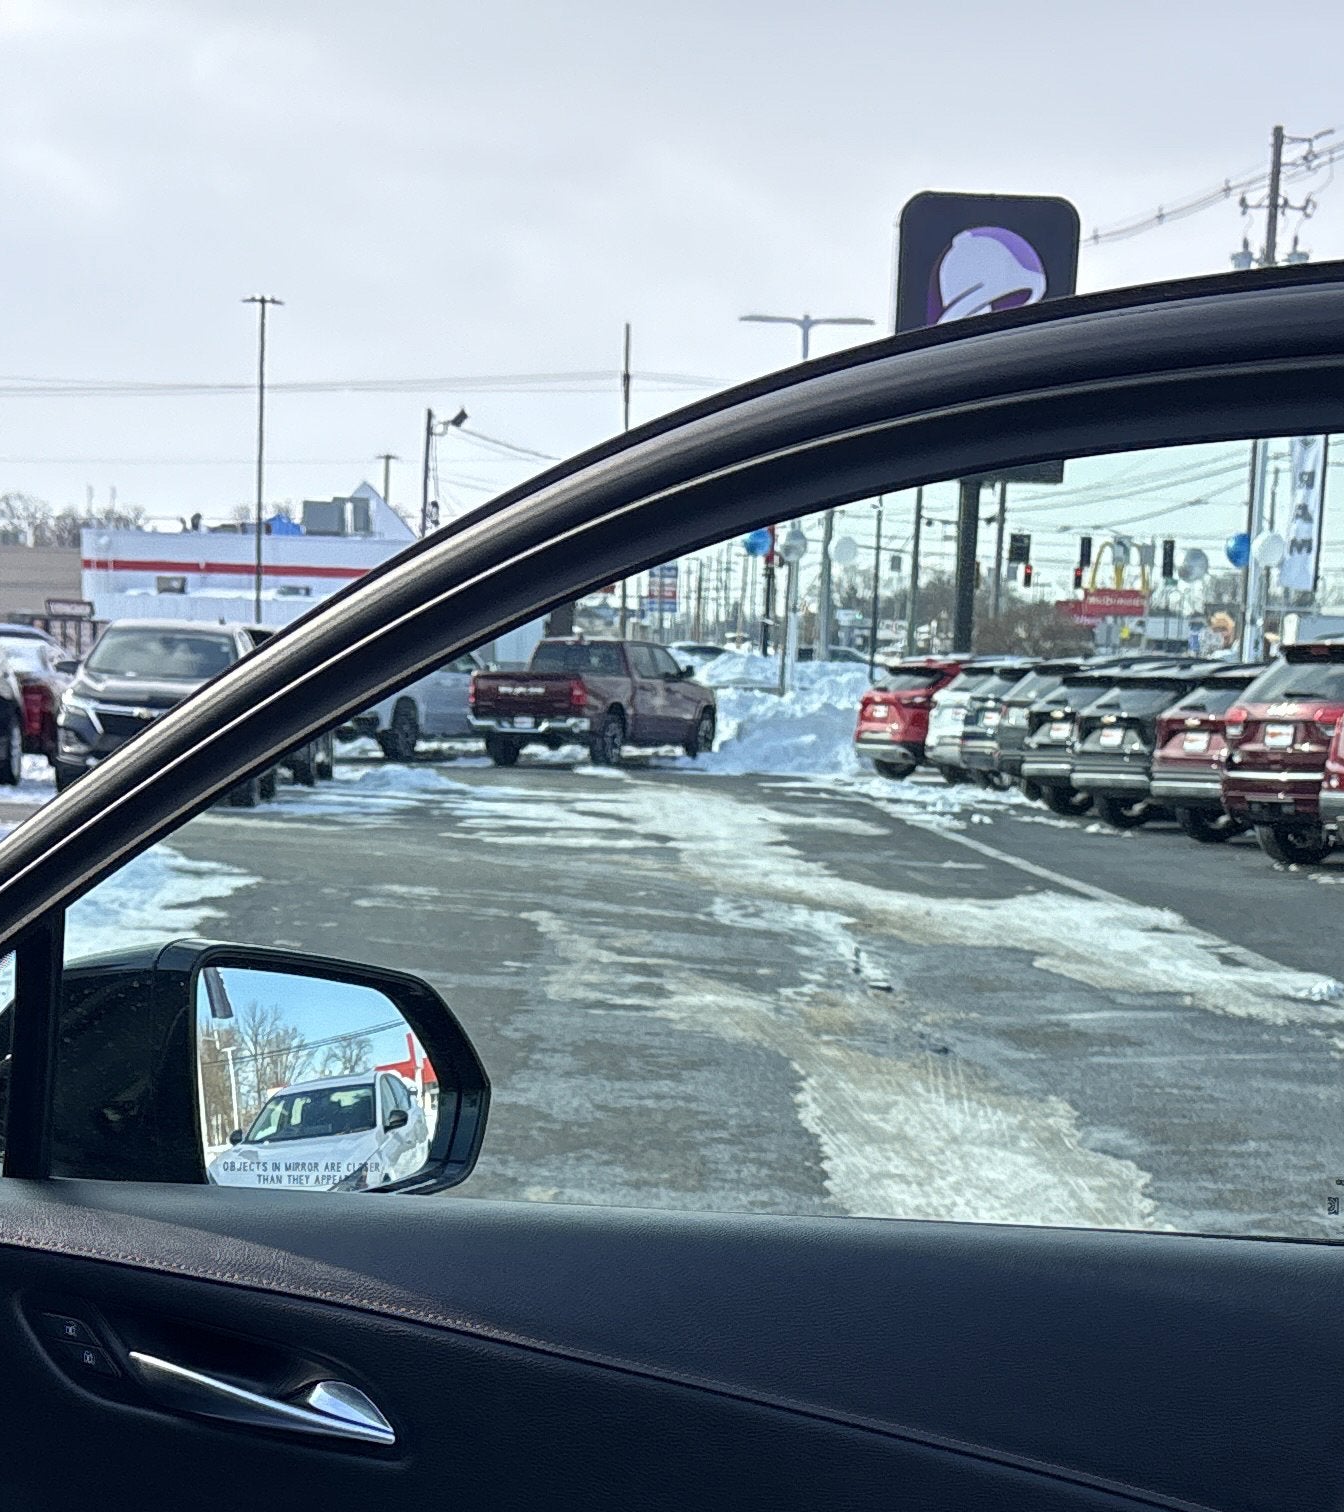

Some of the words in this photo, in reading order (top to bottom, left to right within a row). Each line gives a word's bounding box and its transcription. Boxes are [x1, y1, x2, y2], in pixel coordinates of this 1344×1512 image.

[222, 1161, 268, 1172] OBJECTS
[271, 1161, 281, 1172] IN
[284, 1161, 320, 1173] MIRROR
[324, 1161, 342, 1173] ARE
[257, 1174, 283, 1184] THAN
[287, 1174, 310, 1184] THEY
[314, 1174, 349, 1184] APPEA
